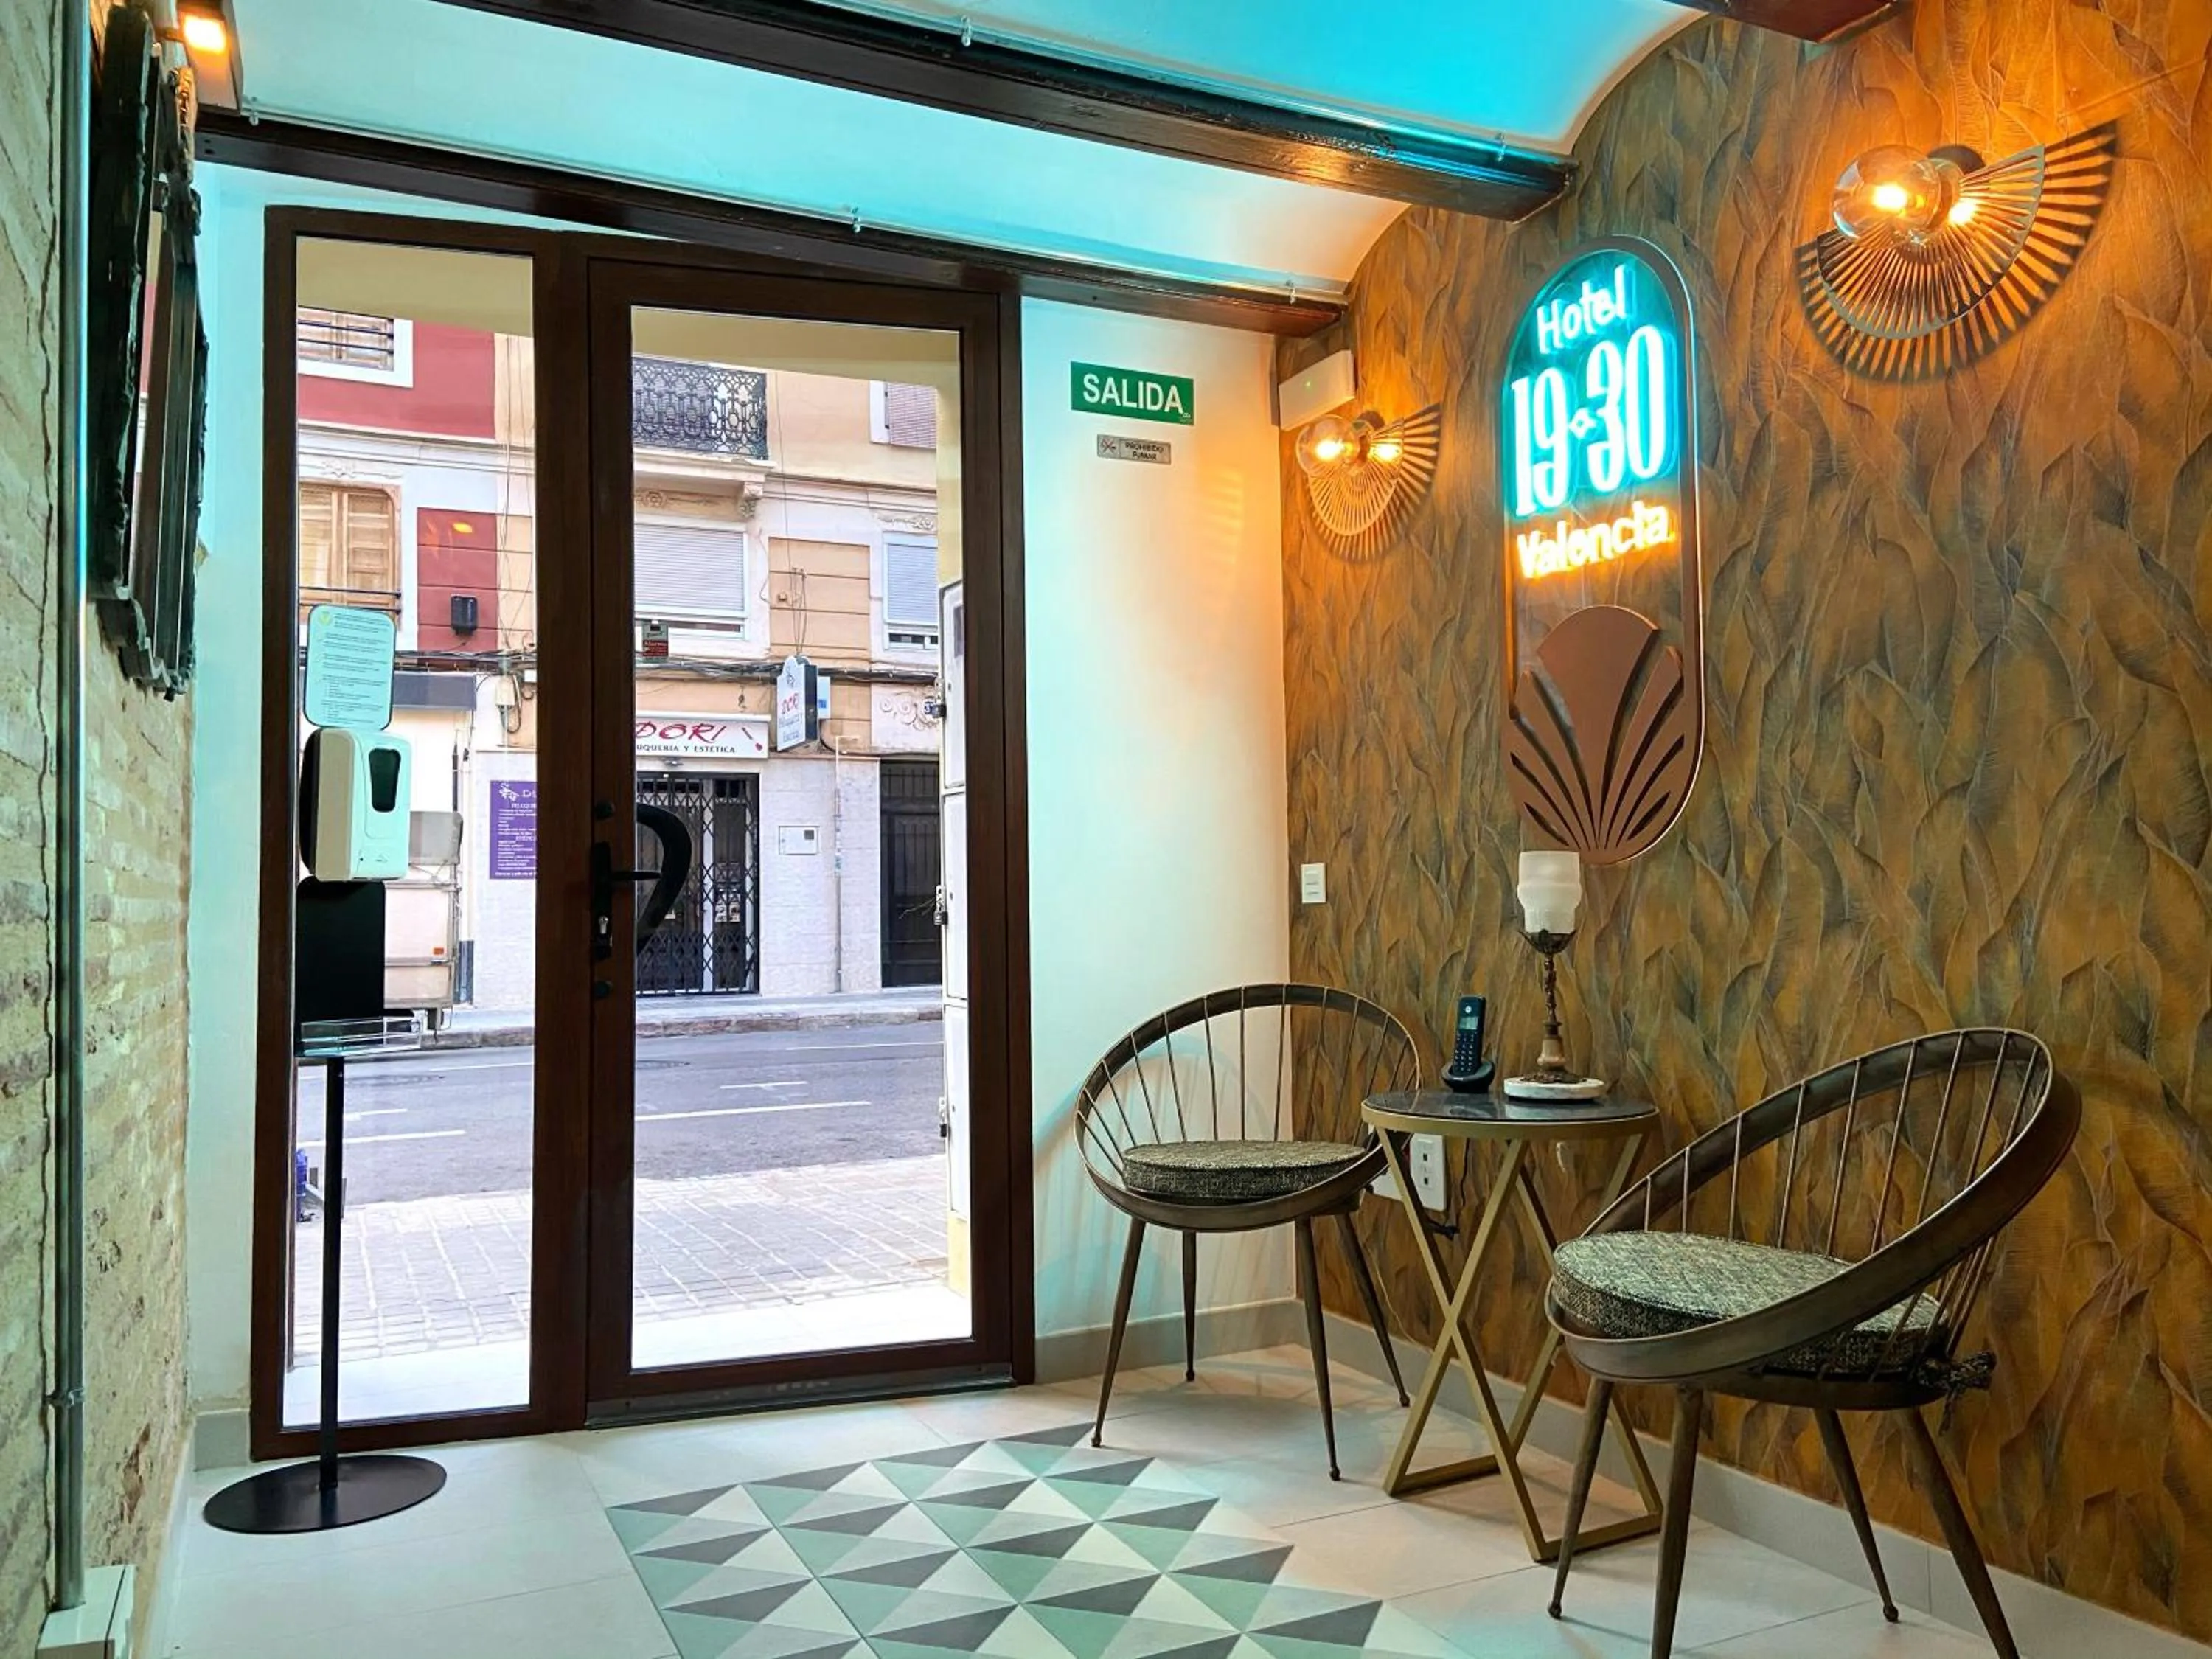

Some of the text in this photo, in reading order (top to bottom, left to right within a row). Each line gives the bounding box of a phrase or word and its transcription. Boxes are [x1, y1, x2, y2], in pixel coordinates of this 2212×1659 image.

[1536, 264, 1627, 354] Hotel
[1082, 372, 1183, 414] SALIDA
[1516, 500, 1672, 580] Valencia
[636, 720, 726, 743] DORI
